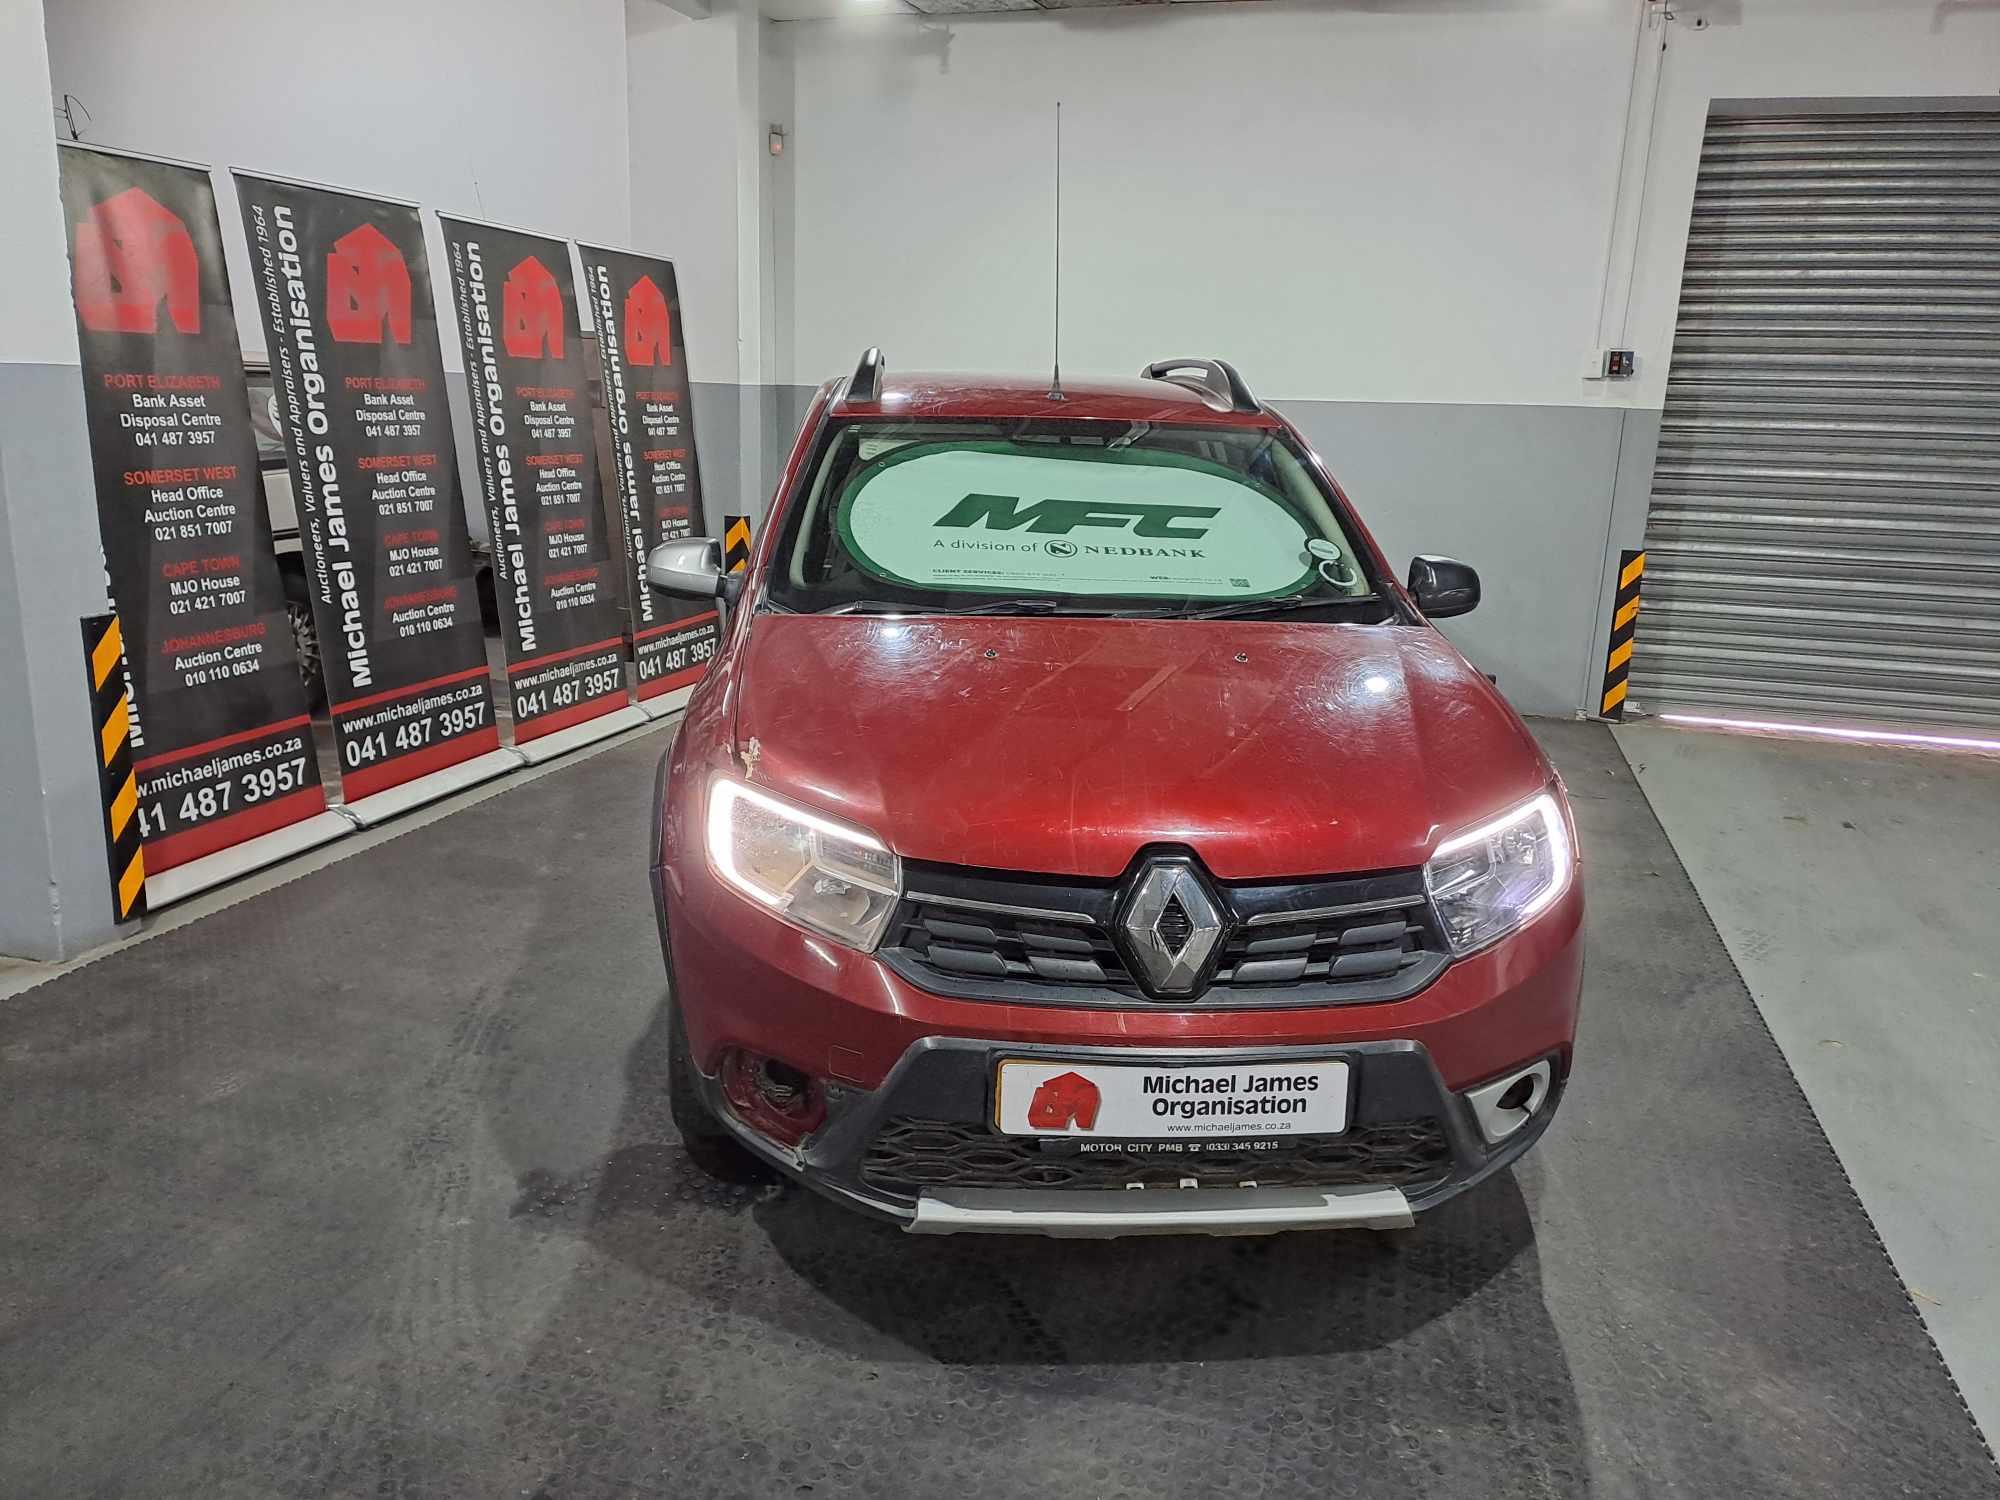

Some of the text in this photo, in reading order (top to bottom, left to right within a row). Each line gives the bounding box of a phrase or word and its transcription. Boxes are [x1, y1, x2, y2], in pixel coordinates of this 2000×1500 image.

[456, 277, 475, 350] Established
[104, 374, 144, 388] PORT
[132, 393, 206, 408] Bank Asset
[252, 204, 333, 605] Auctioneers, Valuers and Appraisers Established 1964
[364, 394, 415, 405] Bank Asset
[120, 412, 221, 430] Disposal Centre
[355, 409, 426, 423] Disposal Centre
[135, 431, 215, 446] 041 487 3957
[366, 425, 421, 437] 041 487 3957
[478, 429, 489, 454] and
[273, 206, 373, 689] Michael James Organisation
[467, 242, 537, 652] Michael James Organisation
[597, 265, 654, 622] Michael James Organisation
[123, 465, 238, 486] SOMERSET WEST
[376, 470, 427, 484] Head Office
[483, 456, 497, 502] Valuers
[151, 486, 223, 503] Head Office
[372, 485, 436, 500] Auction Centre
[536, 482, 561, 493] Auction
[144, 503, 236, 523] Auction Centre
[379, 500, 433, 516] 021 851 7007
[932, 493, 1222, 540] MFC
[155, 520, 233, 541] 021 851 7007
[563, 533, 585, 543] House
[389, 546, 439, 561] MJO House
[561, 546, 572, 557] 421
[933, 539, 945, 548] A
[950, 540, 1015, 552] division
[1021, 542, 1038, 552] of
[1085, 544, 1207, 559] NEDBANK
[162, 555, 240, 577] CAPE TOWN
[389, 559, 443, 577] 021 421 7007
[170, 576, 240, 596] MJO House
[170, 590, 246, 615] 021 421 7007
[392, 603, 455, 623] Auction Centre
[162, 622, 267, 653] JOHANNESBURG
[399, 617, 453, 637] 010 110 0634
[175, 643, 263, 671] Auction Centre
[639, 637, 717, 680] 041 487 3957
[185, 658, 260, 687] 010 110 0634
[514, 653, 618, 690] www.michaeljames.co.za
[517, 668, 619, 718] 041 487 3957
[342, 684, 483, 734] www.michaeljames.co.za
[345, 701, 486, 767] 041 487 3957
[136, 736, 302, 799] w.michaeljames.co.za
[179, 780, 232, 822] 487
[241, 757, 307, 802] 3957
[1142, 1072, 1319, 1095] Michael James
[1152, 1095, 1308, 1119] Organisation
[1166, 1121, 1292, 1135] www.michaeljames.co.za
[1080, 1143, 1122, 1152] MOTOR
[1127, 1143, 1153, 1152] CITY
[1158, 1143, 1183, 1152] PMB
[1232, 1142, 1251, 1151] 345
[1253, 1141, 1279, 1150] 9215
